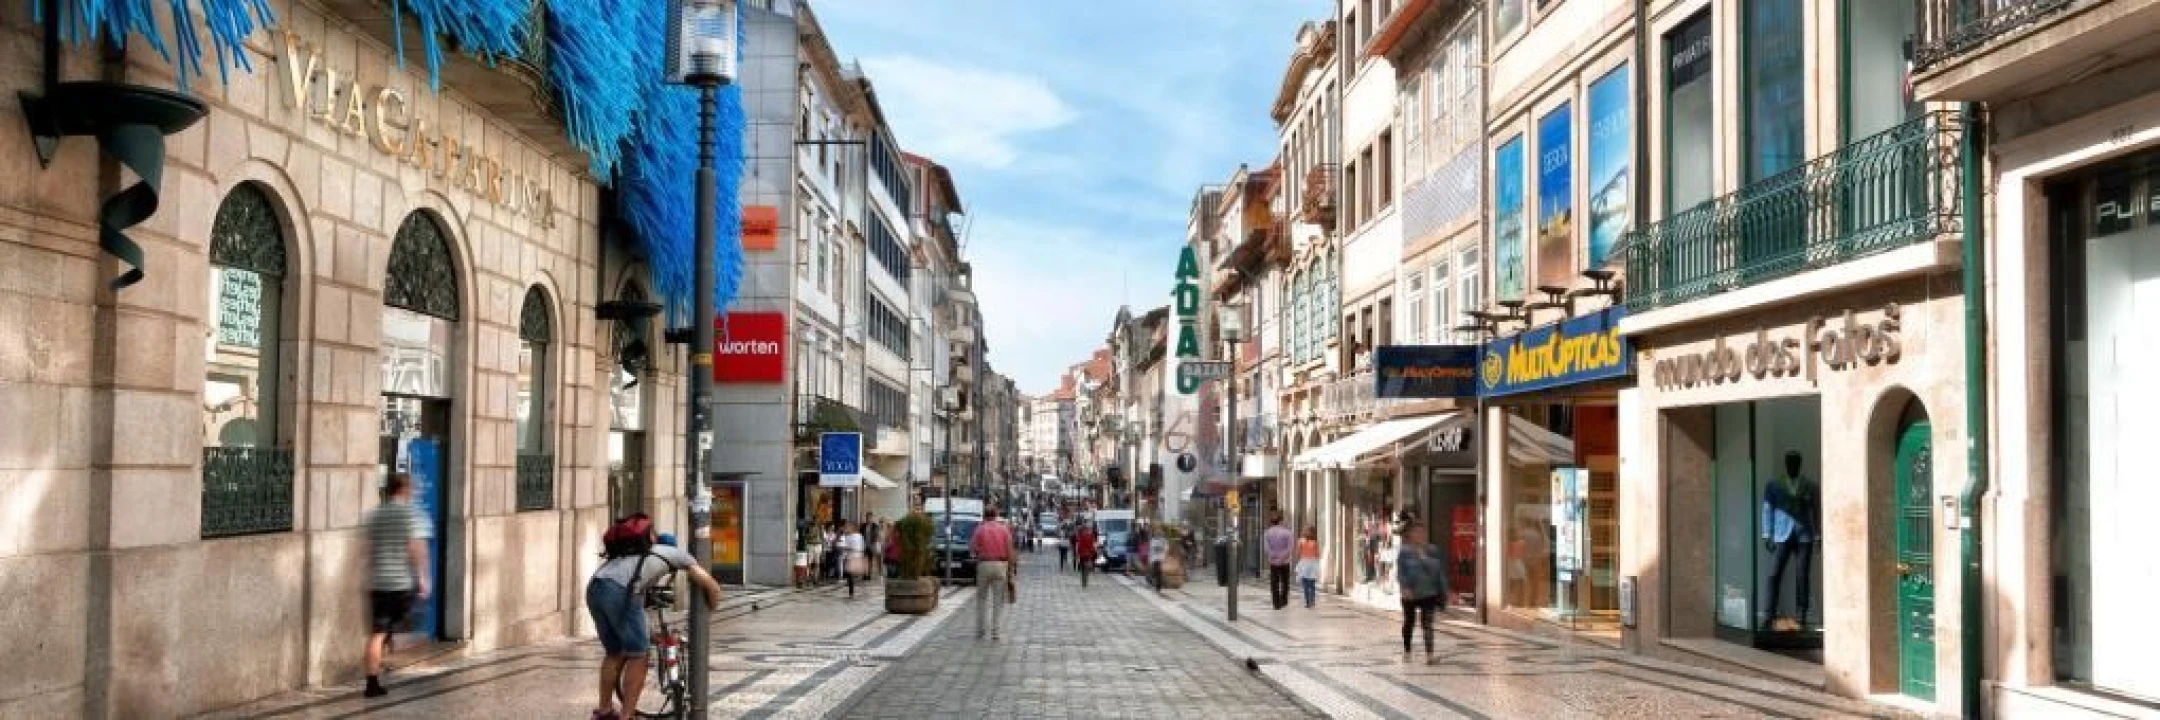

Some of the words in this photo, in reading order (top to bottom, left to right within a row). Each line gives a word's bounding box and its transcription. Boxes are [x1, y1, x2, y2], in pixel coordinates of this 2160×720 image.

[719, 340, 778, 355] worten
[1654, 334, 1742, 392] mundo
[1745, 326, 1799, 381] dos
